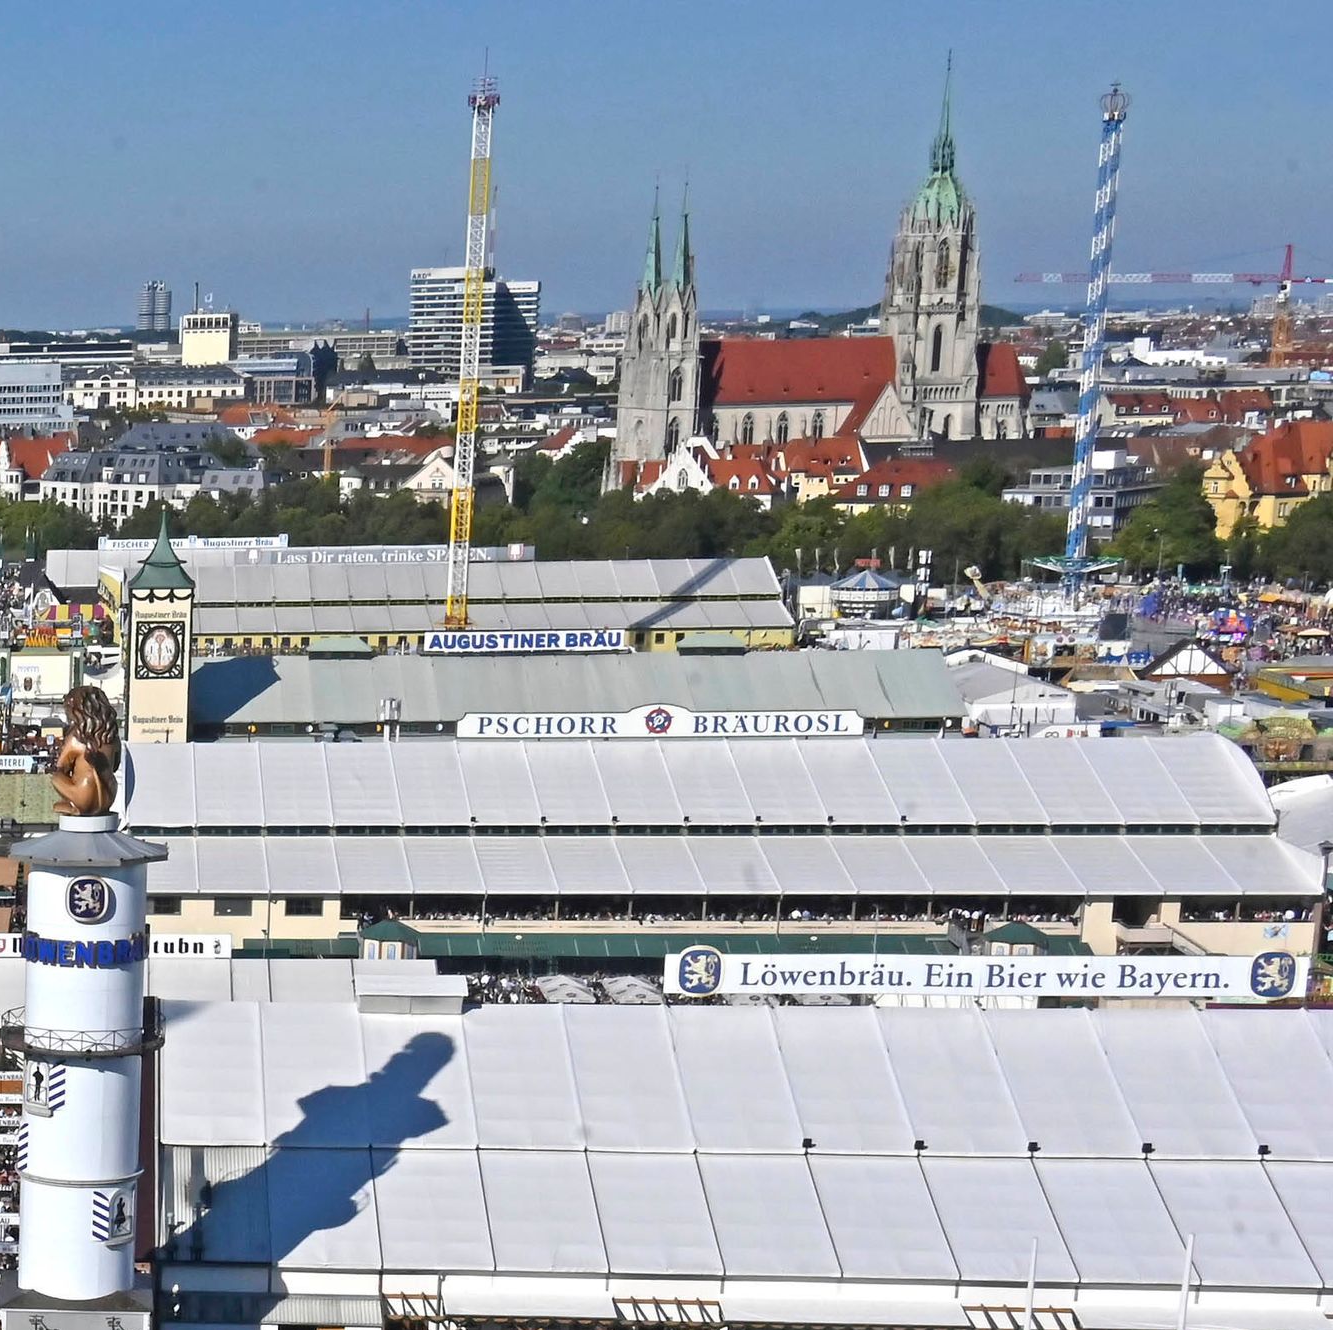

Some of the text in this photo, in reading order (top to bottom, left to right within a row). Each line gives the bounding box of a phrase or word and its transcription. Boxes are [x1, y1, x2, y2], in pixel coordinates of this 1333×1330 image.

[112, 539, 149, 549] FISCHER
[203, 538, 251, 548] Augustiner
[277, 548, 492, 564] Lass Dir raten, trinke SPAEN.
[135, 610, 171, 620] Augustiner
[429, 629, 621, 649] AUGUSTINER BRÄU
[132, 715, 167, 725] Augustiner
[477, 713, 849, 735] PSCHORR BRÄUROSL
[740, 960, 1230, 997] Löwenbräu. Ein Bier wie Bayern.
